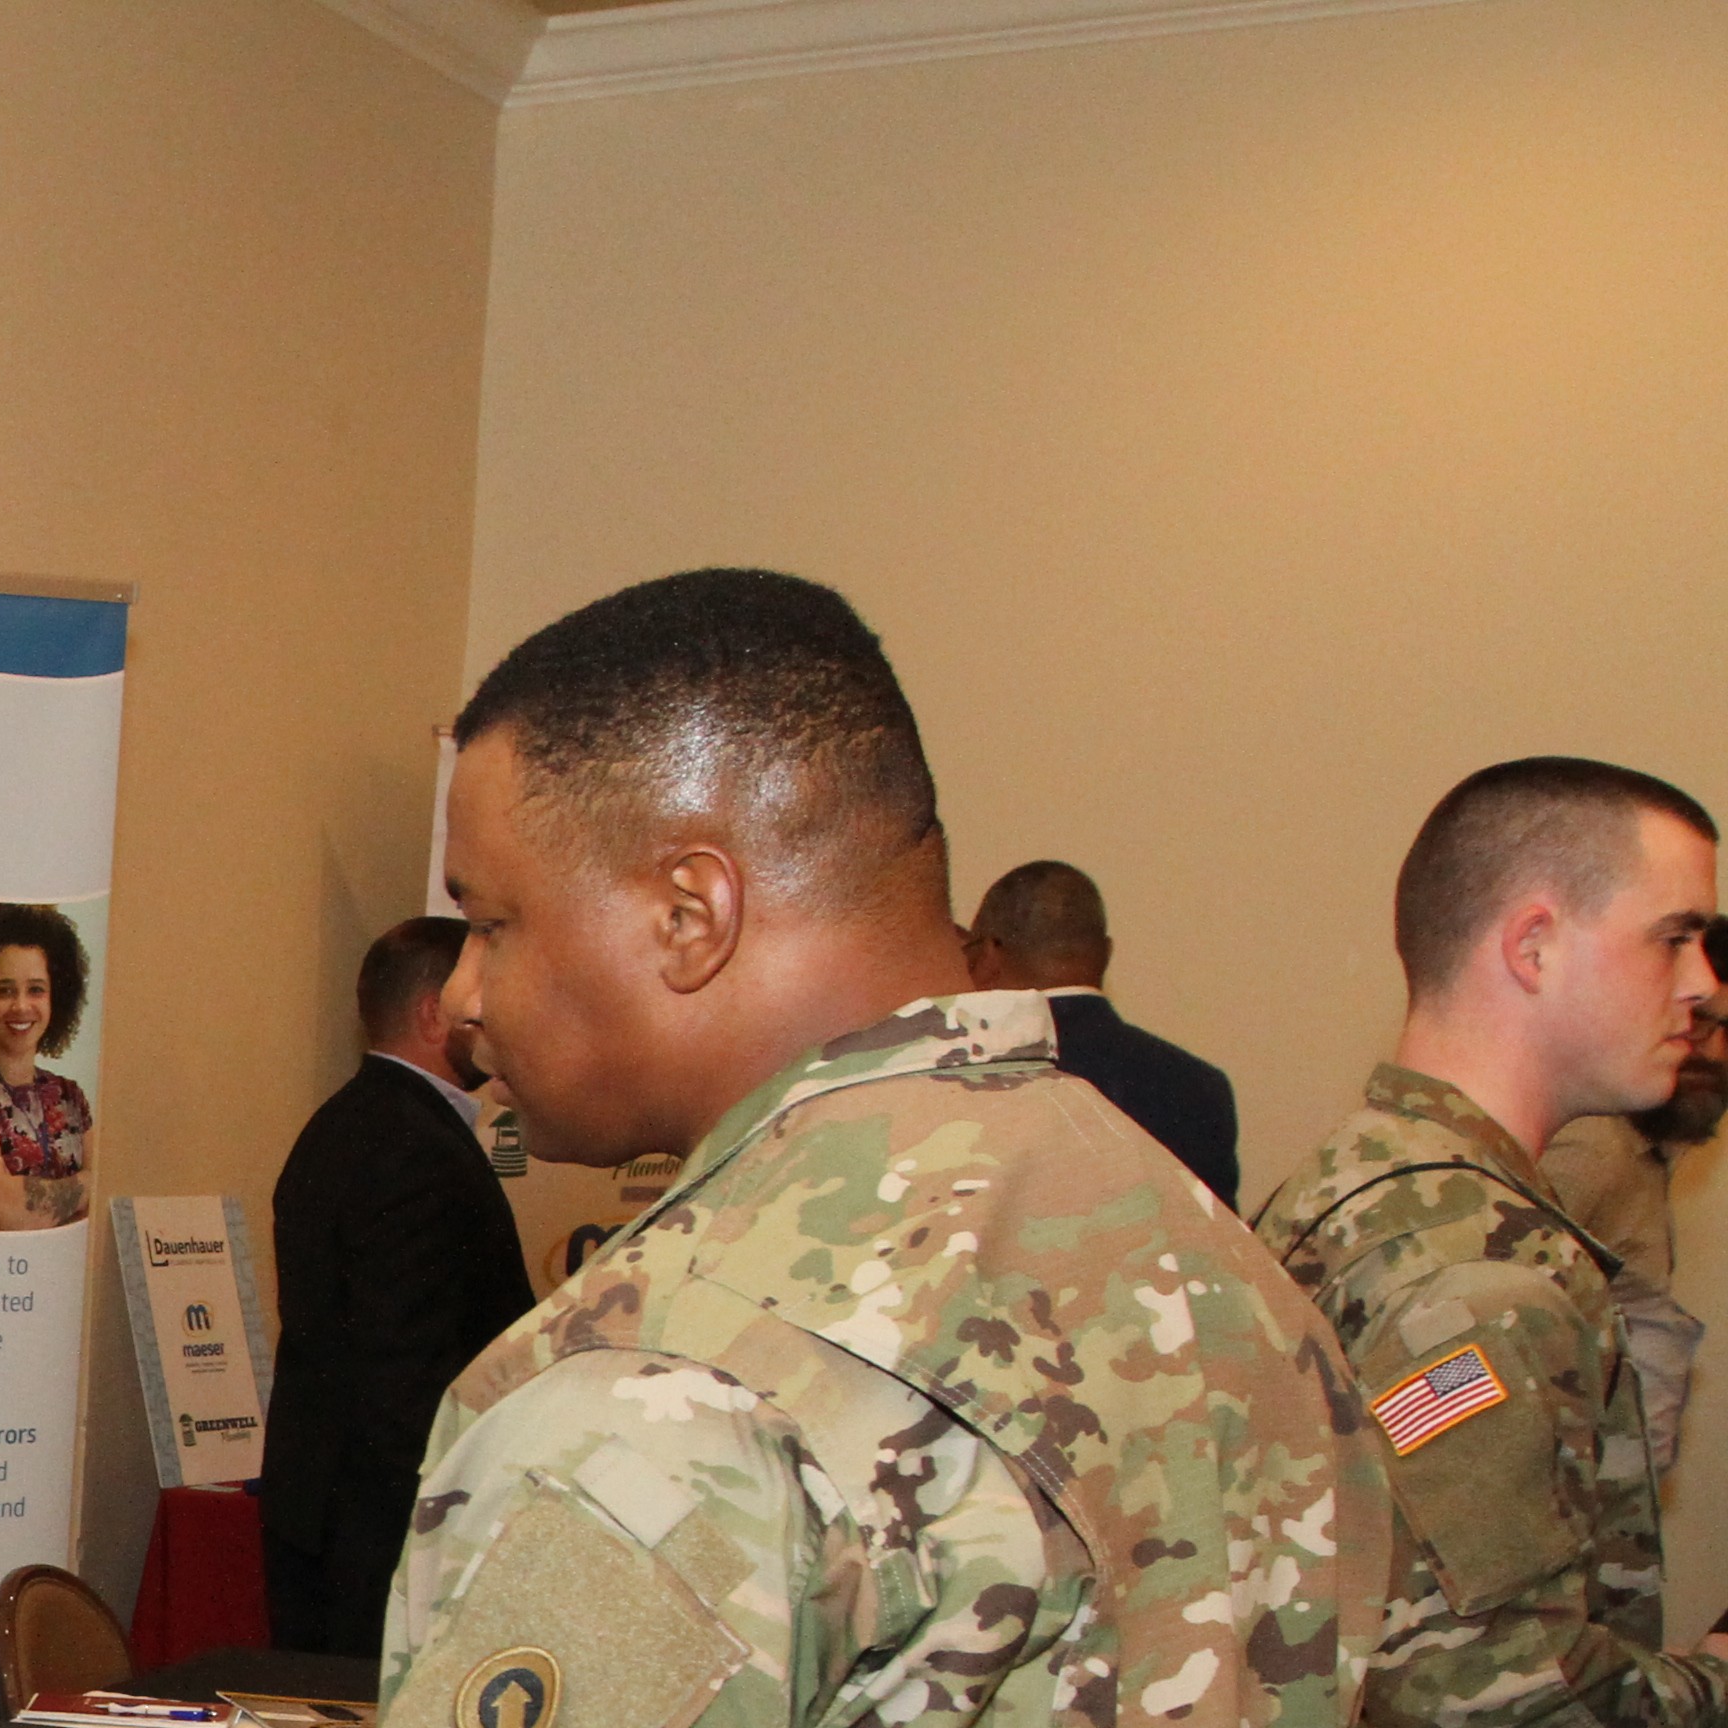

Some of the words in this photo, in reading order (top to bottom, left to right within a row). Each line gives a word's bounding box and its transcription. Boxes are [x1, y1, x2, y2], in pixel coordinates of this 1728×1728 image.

[154, 1237, 224, 1254] Dauenhauer
[8, 1256, 29, 1276] to
[195, 1417, 257, 1432] GREENWELL
